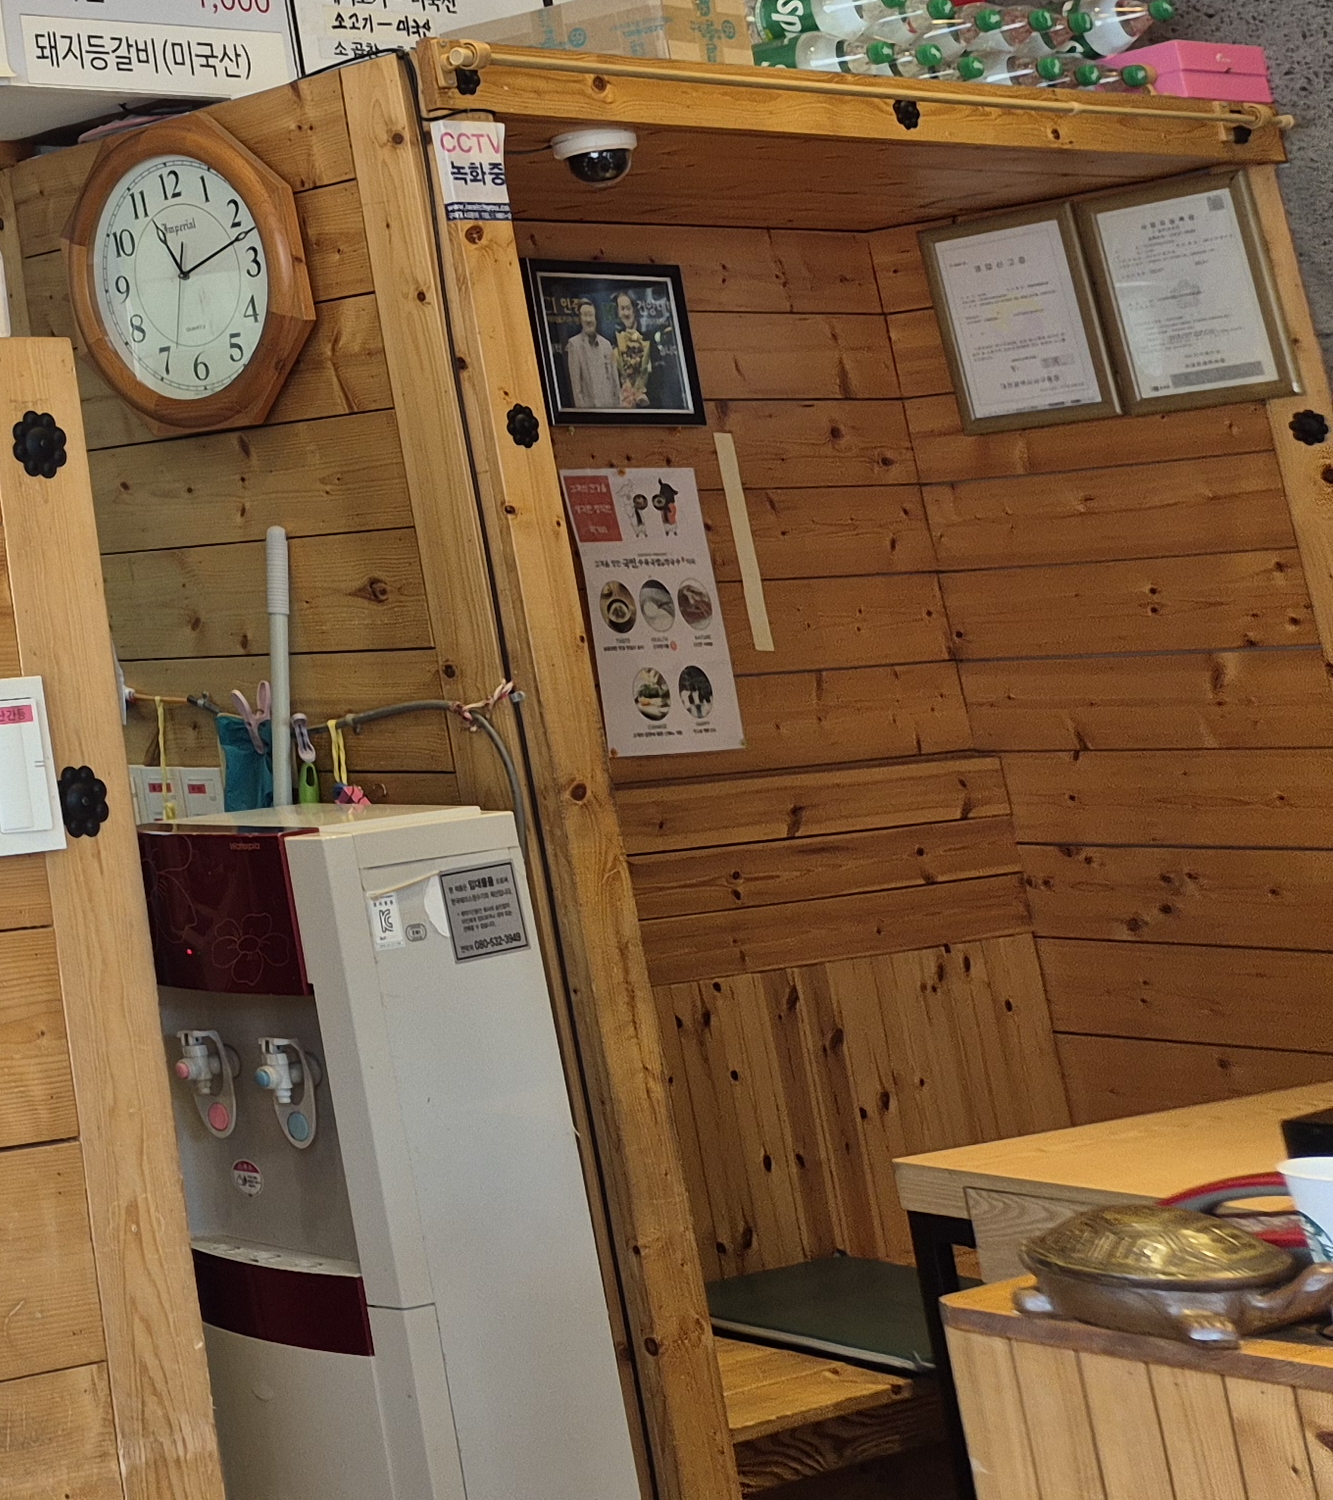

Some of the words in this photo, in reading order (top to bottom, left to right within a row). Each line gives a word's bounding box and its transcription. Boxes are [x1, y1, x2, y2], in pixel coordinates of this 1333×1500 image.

[332, 11, 373, 33] 소고기
[34, 31, 252, 81] 돼지등갈비(미국산)
[440, 132, 500, 154] CCTV
[158, 170, 182, 200] 12
[451, 161, 506, 186] 녹화중
[200, 175, 210, 203] 1
[130, 190, 149, 220] 11
[226, 199, 242, 228] 2
[113, 229, 136, 258] 10
[245, 246, 261, 277] 3
[115, 275, 130, 304] 9
[243, 295, 259, 323] 4
[130, 314, 146, 343] 8
[158, 345, 172, 375] 7
[229, 332, 244, 362] 5
[193, 352, 210, 381] 6
